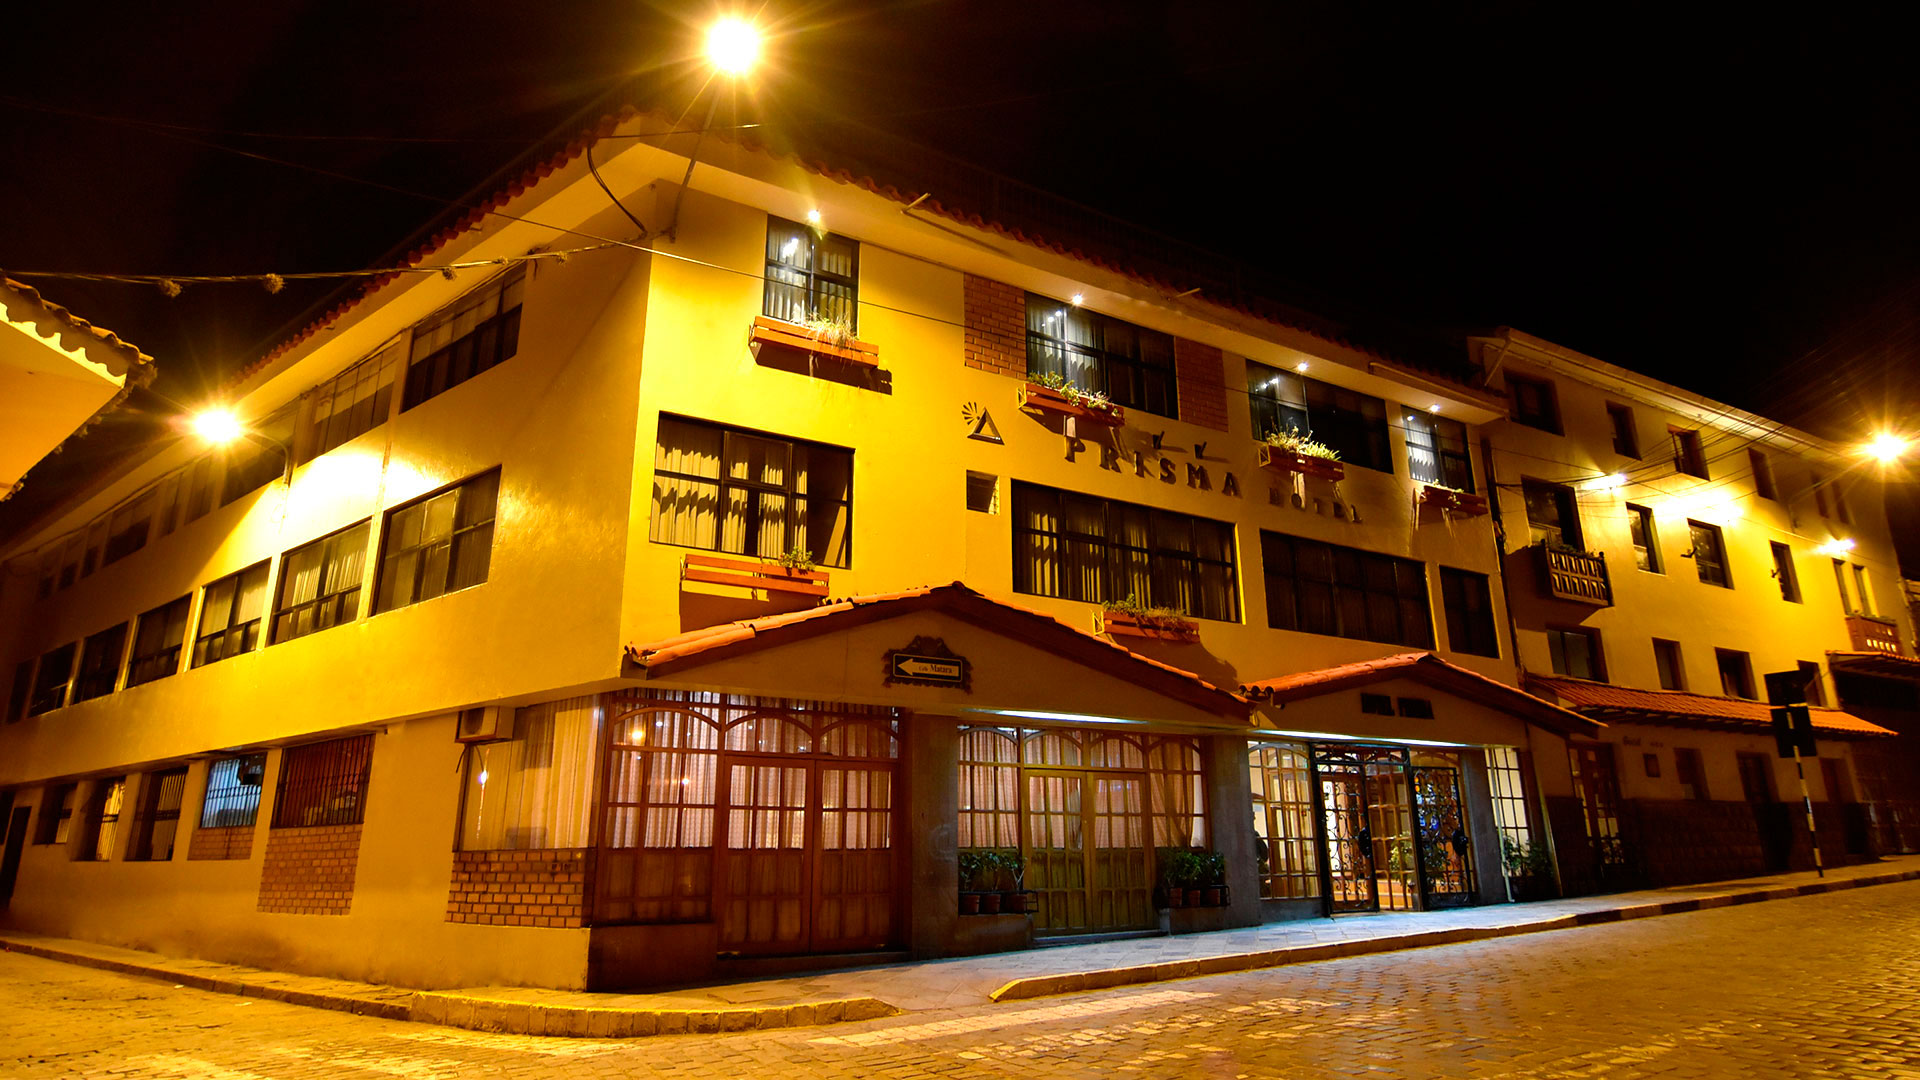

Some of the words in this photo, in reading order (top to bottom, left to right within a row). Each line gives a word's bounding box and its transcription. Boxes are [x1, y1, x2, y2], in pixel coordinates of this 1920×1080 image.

[1064, 435, 1241, 498] PRISMA
[1268, 487, 1363, 524] HOTEL
[930, 664, 953, 674] Matara
